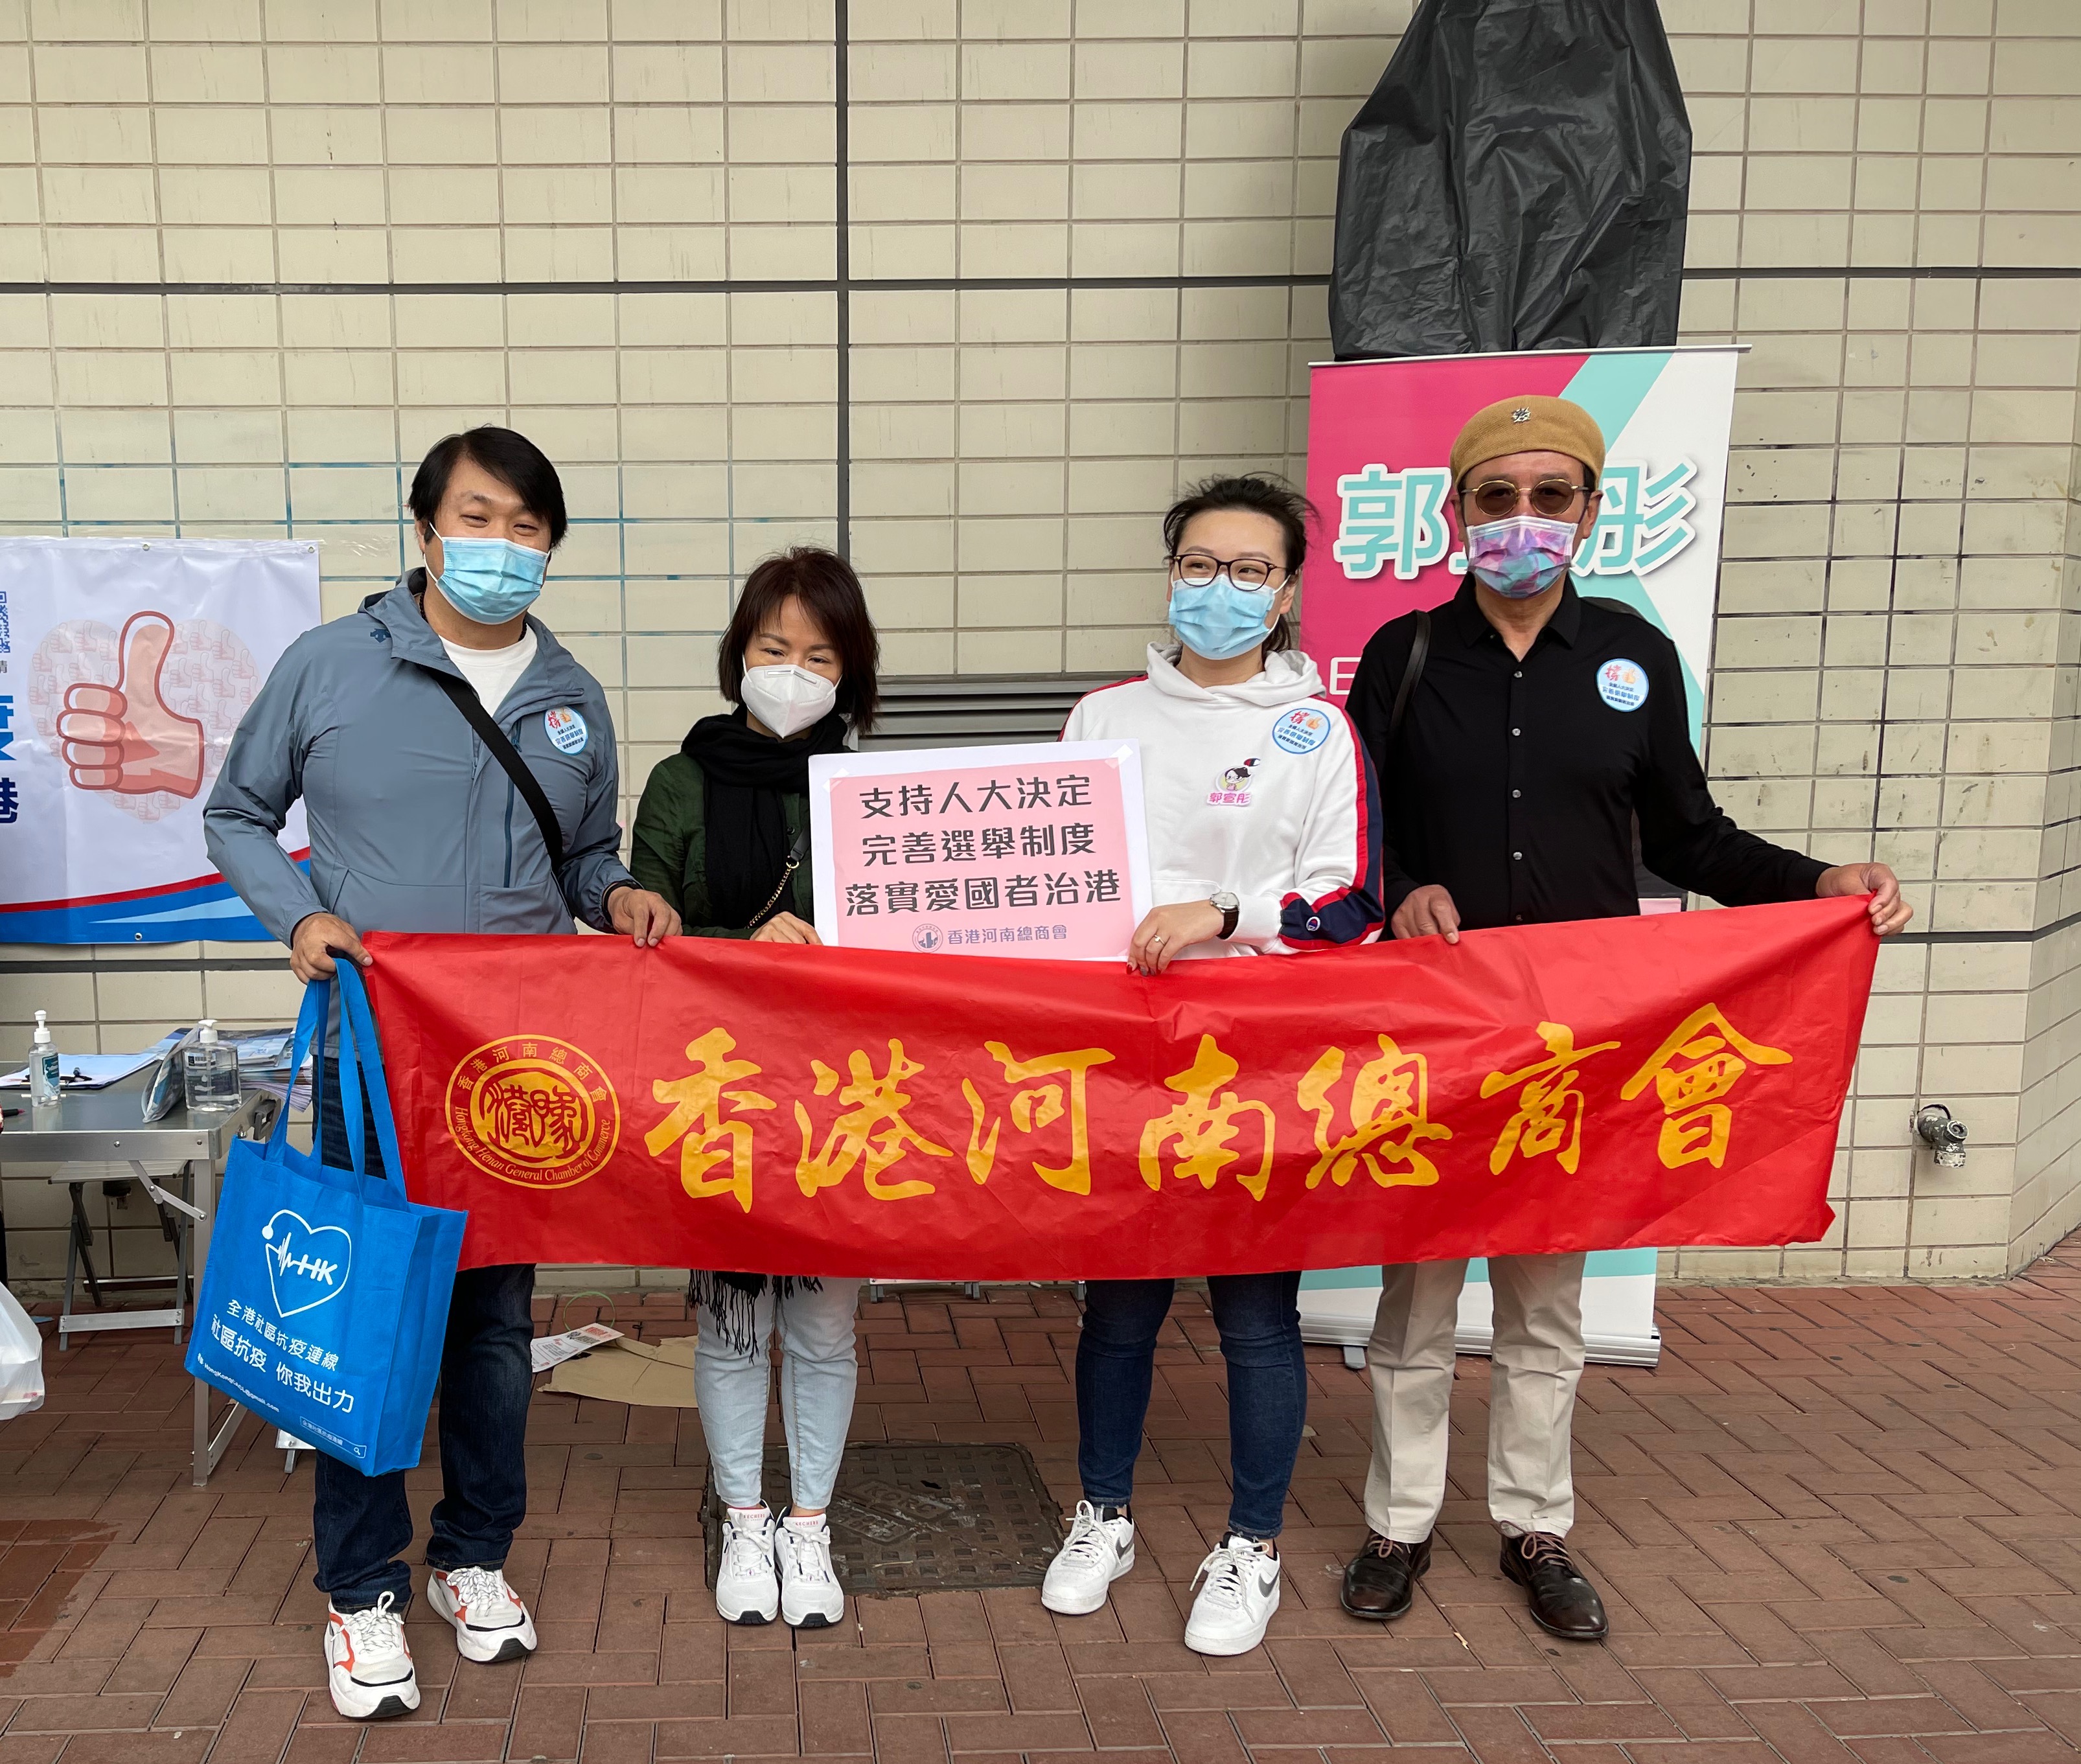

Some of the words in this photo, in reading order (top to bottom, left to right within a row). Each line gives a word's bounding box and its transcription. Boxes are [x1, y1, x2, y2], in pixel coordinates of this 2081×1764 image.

[1333, 455, 1697, 580] 郭彤
[859, 774, 1092, 819] 支持人大決定
[862, 822, 1096, 867] 完善選舉制度
[845, 869, 1121, 917] 落實愛國者治港
[948, 925, 1068, 945] 香港河南總商會
[457, 1042, 608, 1103] 香港河南總商會
[454, 1106, 479, 1151] Hongkong
[643, 1002, 1794, 1213] 香港河南總商會
[476, 1147, 505, 1171] Henan
[582, 1152, 595, 1169] of
[586, 1119, 611, 1162] Commerce
[505, 1163, 543, 1181] General
[544, 1163, 583, 1182] Chamber
[225, 1298, 339, 1371] 全港社區抗疫連線
[211, 1313, 267, 1373] 社區抗疫
[275, 1361, 355, 1414] 你我出力
